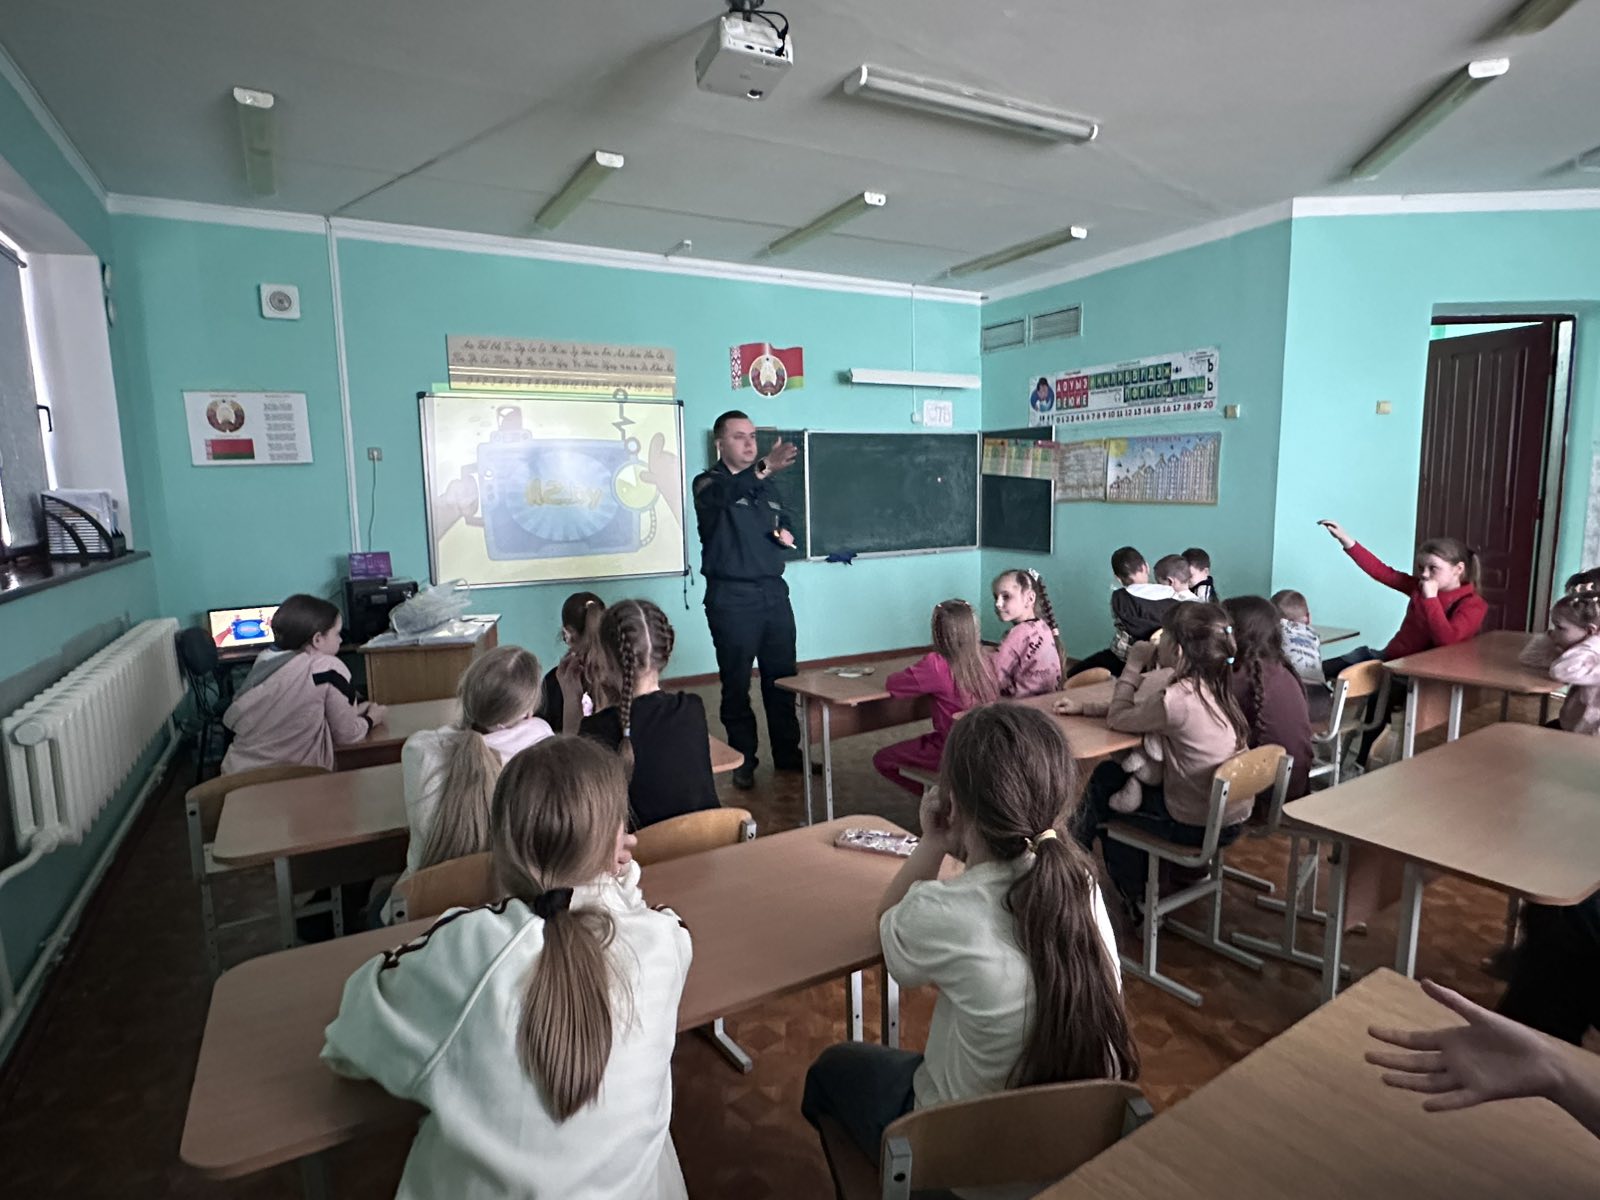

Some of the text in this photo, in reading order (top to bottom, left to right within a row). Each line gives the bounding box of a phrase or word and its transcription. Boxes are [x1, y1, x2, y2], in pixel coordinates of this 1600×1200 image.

[1125, 409, 1132, 417] 12
[1134, 408, 1142, 416] 13
[1143, 407, 1151, 415] 14
[1153, 406, 1161, 414] 15
[1163, 405, 1171, 413] 16
[1173, 404, 1181, 412] 17
[1183, 402, 1192, 411] 18
[1193, 401, 1202, 410] 19
[1203, 400, 1214, 409] 20
